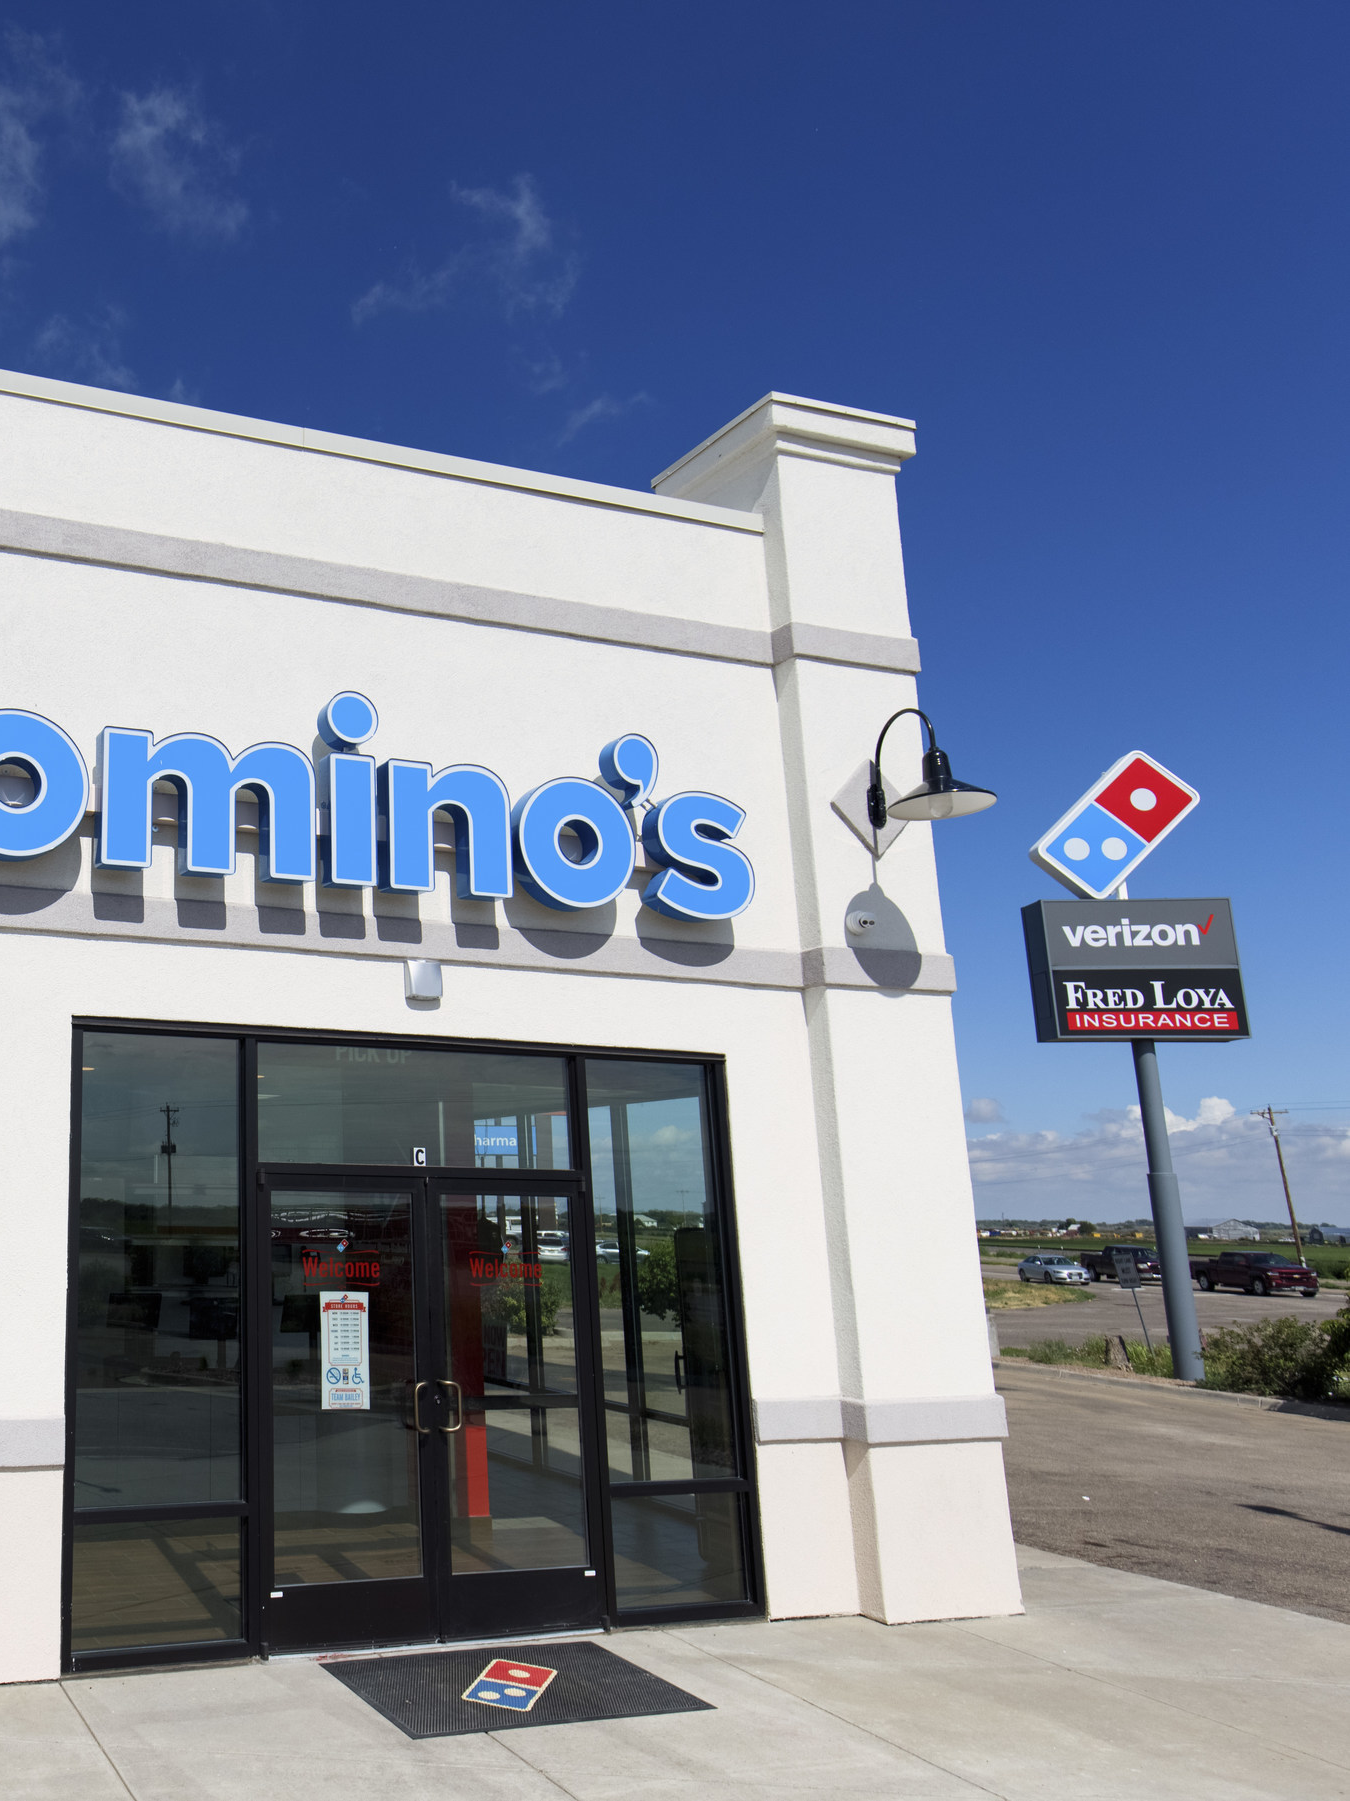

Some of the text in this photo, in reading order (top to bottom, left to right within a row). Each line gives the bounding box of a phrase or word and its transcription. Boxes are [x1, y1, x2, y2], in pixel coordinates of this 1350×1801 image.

[1062, 918, 1200, 947] verizon
[1062, 981, 1235, 1009] FRED LOYA
[1075, 1013, 1230, 1027] INSURANCE
[414, 1148, 425, 1166] C
[302, 1257, 381, 1278] Welcome
[469, 1258, 543, 1279] Welcome
